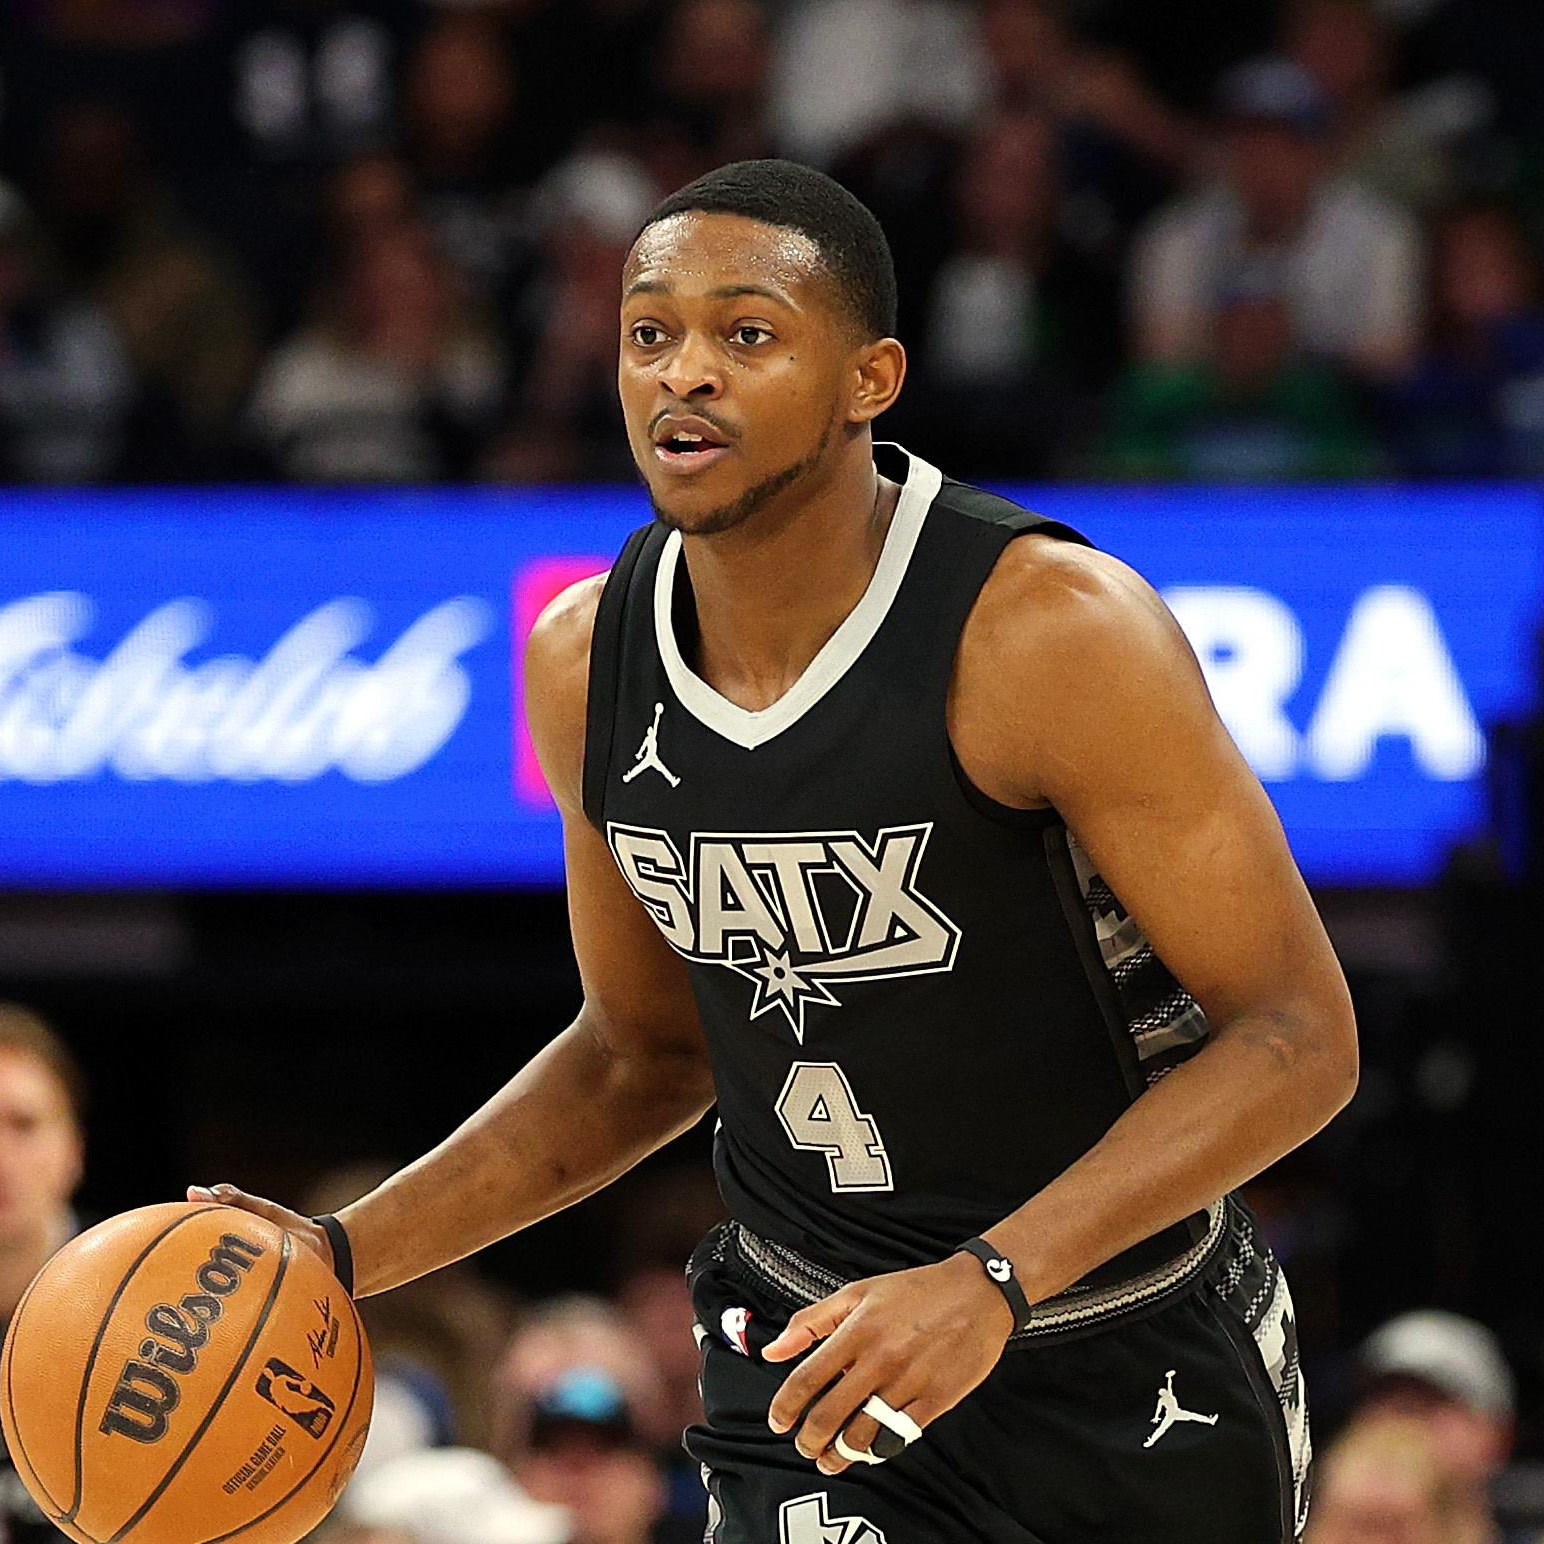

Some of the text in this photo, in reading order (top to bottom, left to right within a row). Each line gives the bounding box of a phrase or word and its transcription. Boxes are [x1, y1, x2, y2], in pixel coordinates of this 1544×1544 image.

[606, 821, 963, 985] SATX
[774, 1061, 895, 1194] 4
[99, 1232, 267, 1445] Wilson
[221, 1423, 287, 1495] OFFICIAL GAME BALL
